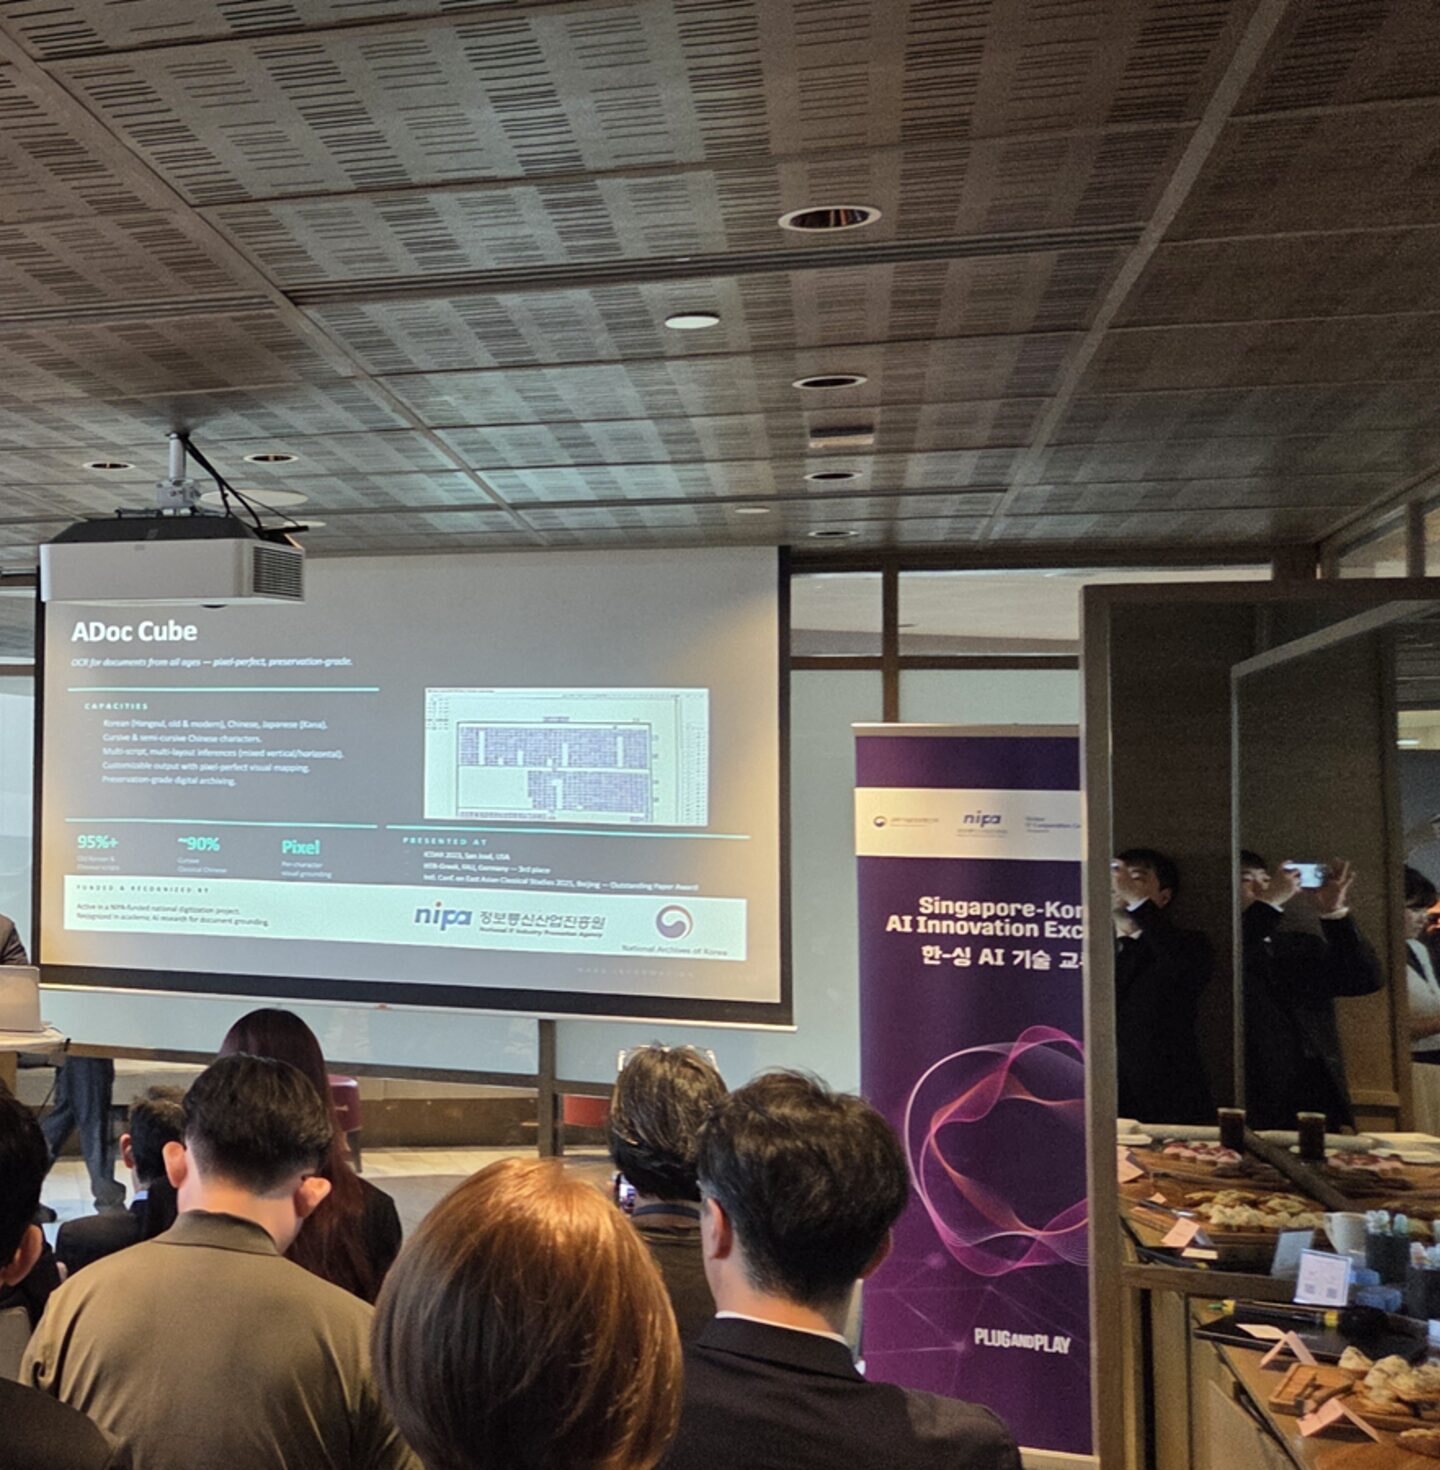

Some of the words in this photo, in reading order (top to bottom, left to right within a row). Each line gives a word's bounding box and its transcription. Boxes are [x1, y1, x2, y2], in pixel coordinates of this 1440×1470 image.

[71, 622, 133, 642] ADoc
[138, 619, 198, 642] Cube
[102, 657, 146, 667] documents
[147, 657, 168, 668] from
[84, 702, 148, 710] CAPACITIES
[963, 810, 1002, 828] nipa
[77, 835, 119, 849] 95%+
[177, 836, 220, 852] ~90%
[282, 839, 320, 855] Pixel
[403, 837, 467, 846] PRESENTED
[415, 901, 473, 931] nipa
[480, 911, 606, 930] 정보통신산업진흥원
[886, 915, 913, 932] AI
[916, 916, 1039, 937] Innovation
[921, 945, 971, 967] 한-싱
[978, 949, 1005, 966] AI
[1012, 949, 1051, 970] 기술
[1059, 951, 1084, 969] 교
